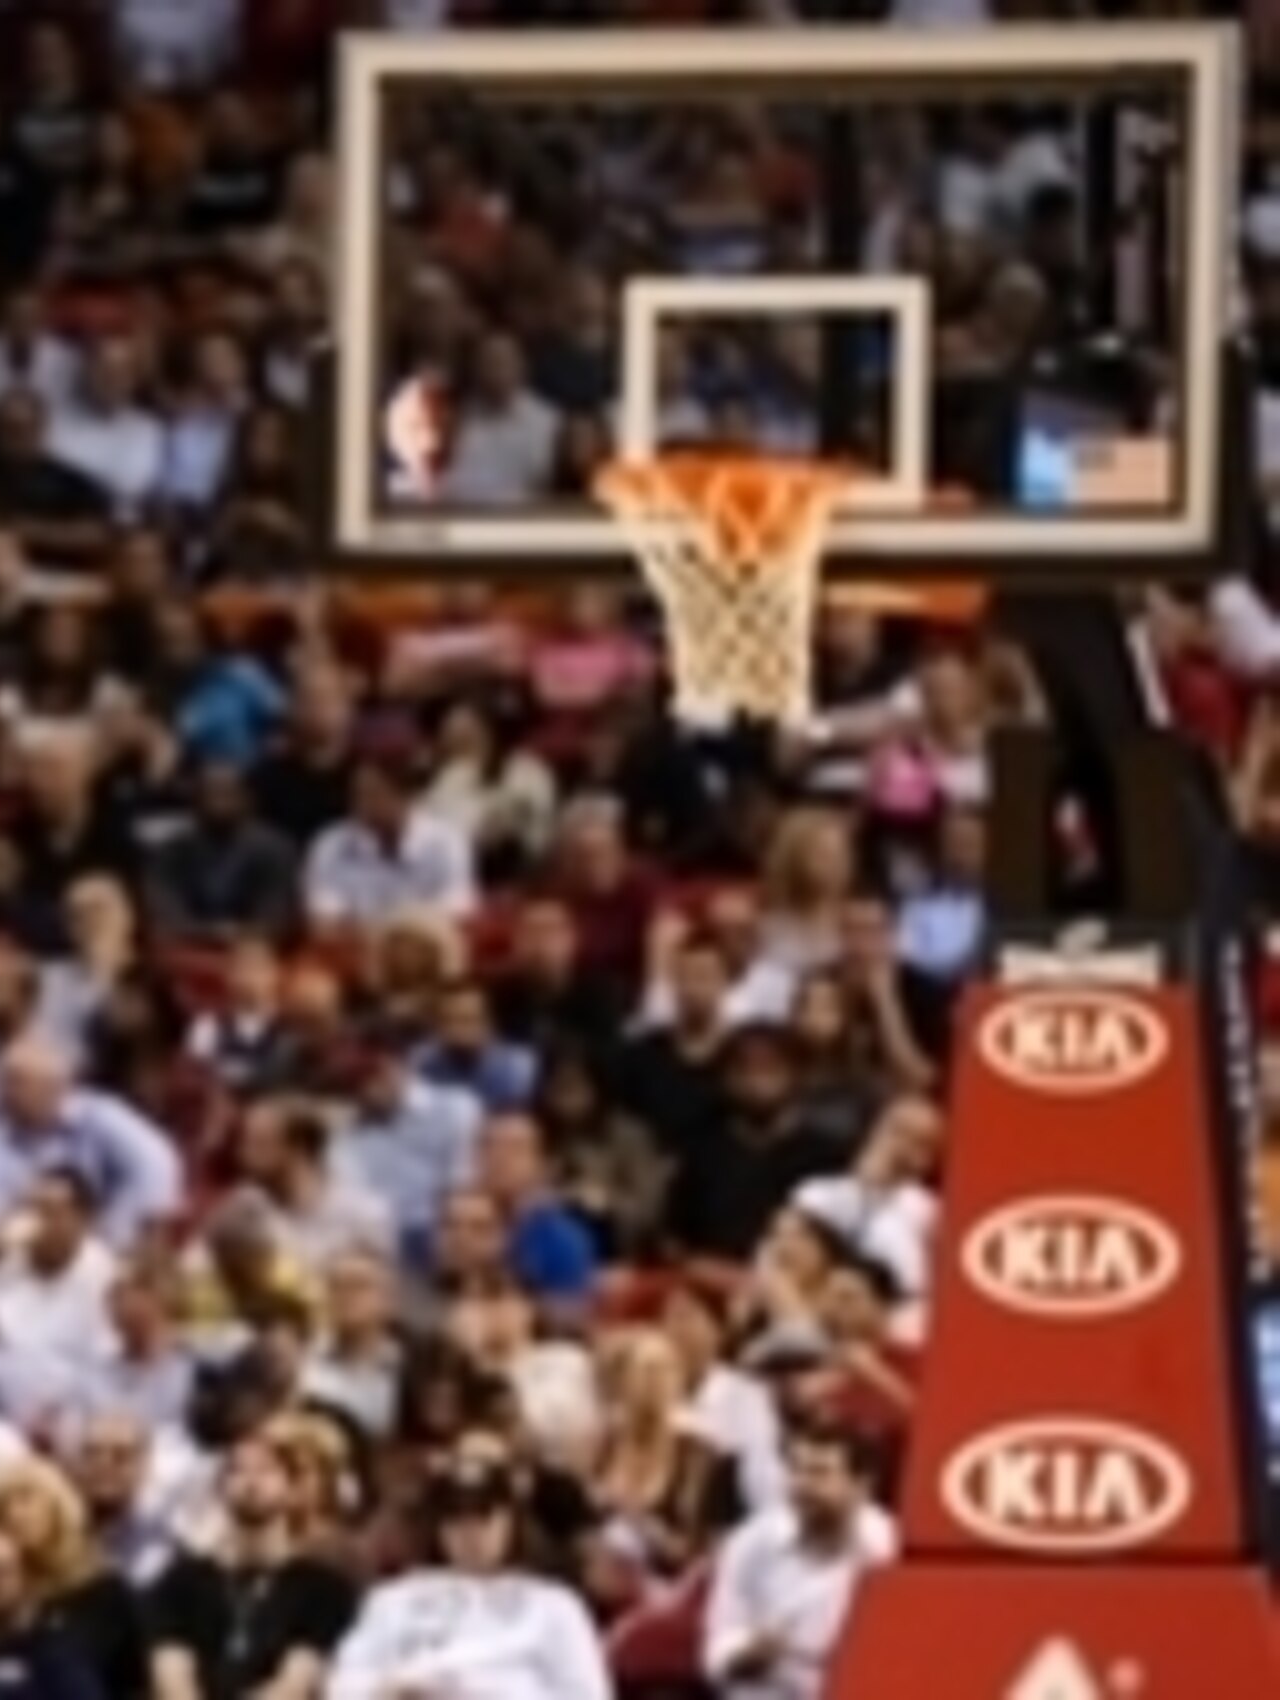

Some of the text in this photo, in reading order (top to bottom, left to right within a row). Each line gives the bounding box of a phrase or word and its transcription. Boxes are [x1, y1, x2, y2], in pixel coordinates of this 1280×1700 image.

[1013, 1008, 1135, 1068] KIA
[1002, 1219, 1143, 1287] KIA
[986, 1447, 1150, 1520] KIA
